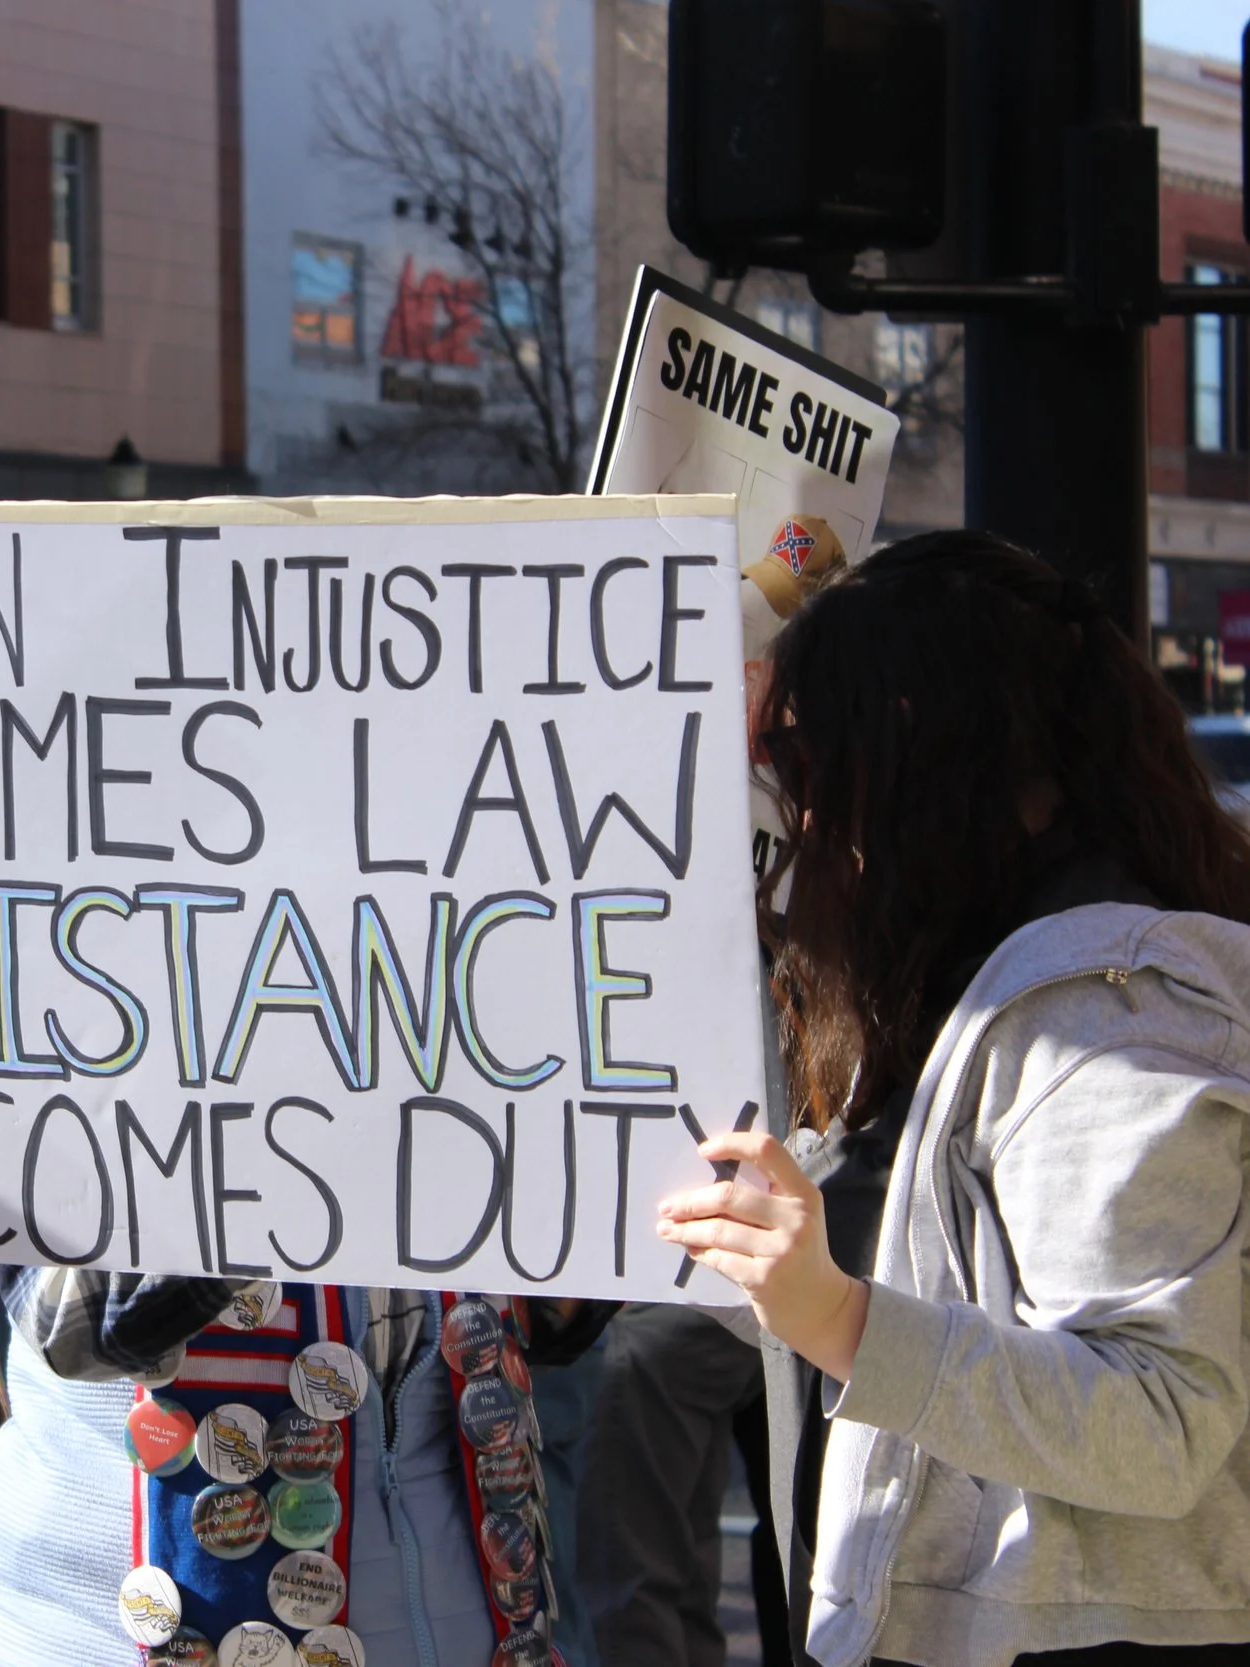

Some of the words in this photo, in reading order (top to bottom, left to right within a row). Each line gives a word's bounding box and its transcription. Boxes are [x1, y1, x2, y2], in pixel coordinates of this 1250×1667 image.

[660, 327, 780, 438] SAME
[782, 391, 873, 484] SHIT
[122, 525, 718, 694] INJUSTICE
[352, 711, 702, 885] LAW
[396, 1095, 759, 1288] DUTY
[465, 1320, 481, 1332] the
[446, 1327, 503, 1353] Constitution
[467, 1377, 502, 1394] DEFEND
[480, 1395, 496, 1407] the
[463, 1406, 517, 1424] Constitution
[140, 1422, 160, 1433] Don't
[162, 1428, 179, 1438] Lose
[290, 1418, 318, 1431] USA
[149, 1433, 170, 1445] Heart
[214, 1494, 243, 1509] USA
[299, 1562, 323, 1575] END
[272, 1571, 343, 1595] BILLIONAIRE
[168, 1640, 195, 1653] USA
[499, 1630, 536, 1653] DEFEND
